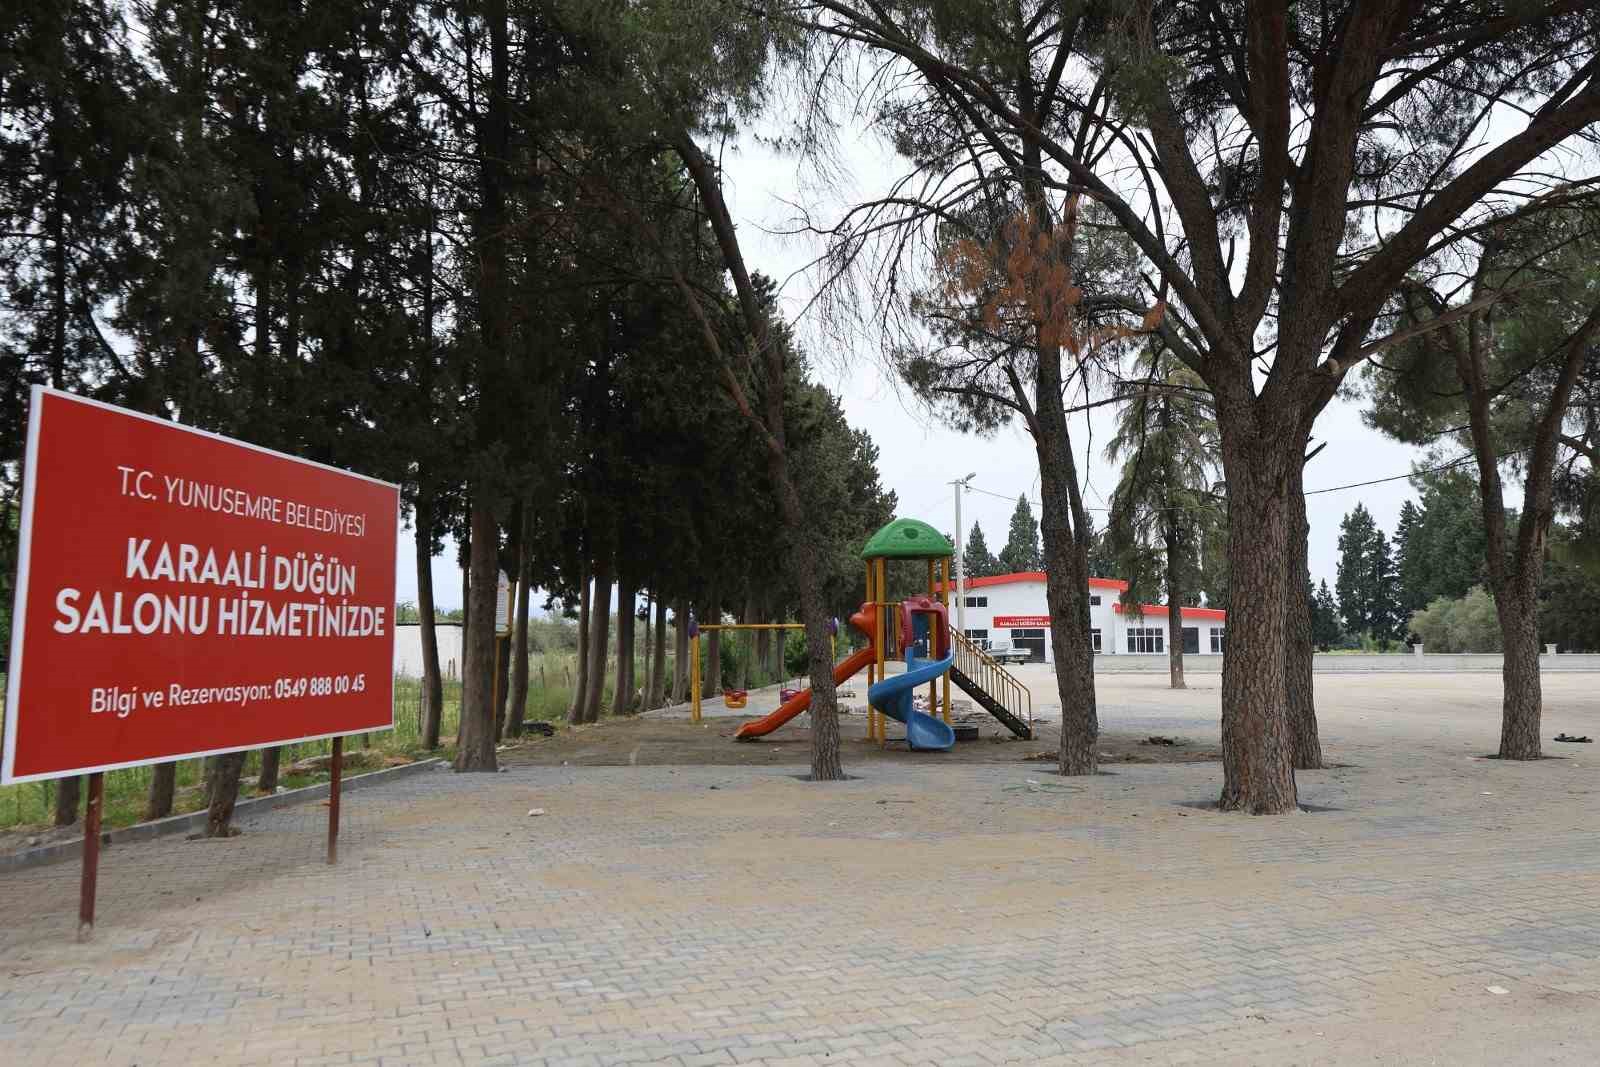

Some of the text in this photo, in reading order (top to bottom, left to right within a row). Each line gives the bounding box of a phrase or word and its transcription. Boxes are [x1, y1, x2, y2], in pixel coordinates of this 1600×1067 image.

[117, 466, 366, 537] T.C. YUNUSEMRE BELEDİYESİ
[126, 537, 356, 595] KARAALİ DÜĞÜN
[53, 587, 385, 637] SALONU HİZMETİNİZDE
[90, 673, 366, 718] Bilgi ve Rezervasyon: 0549 888 00 45
